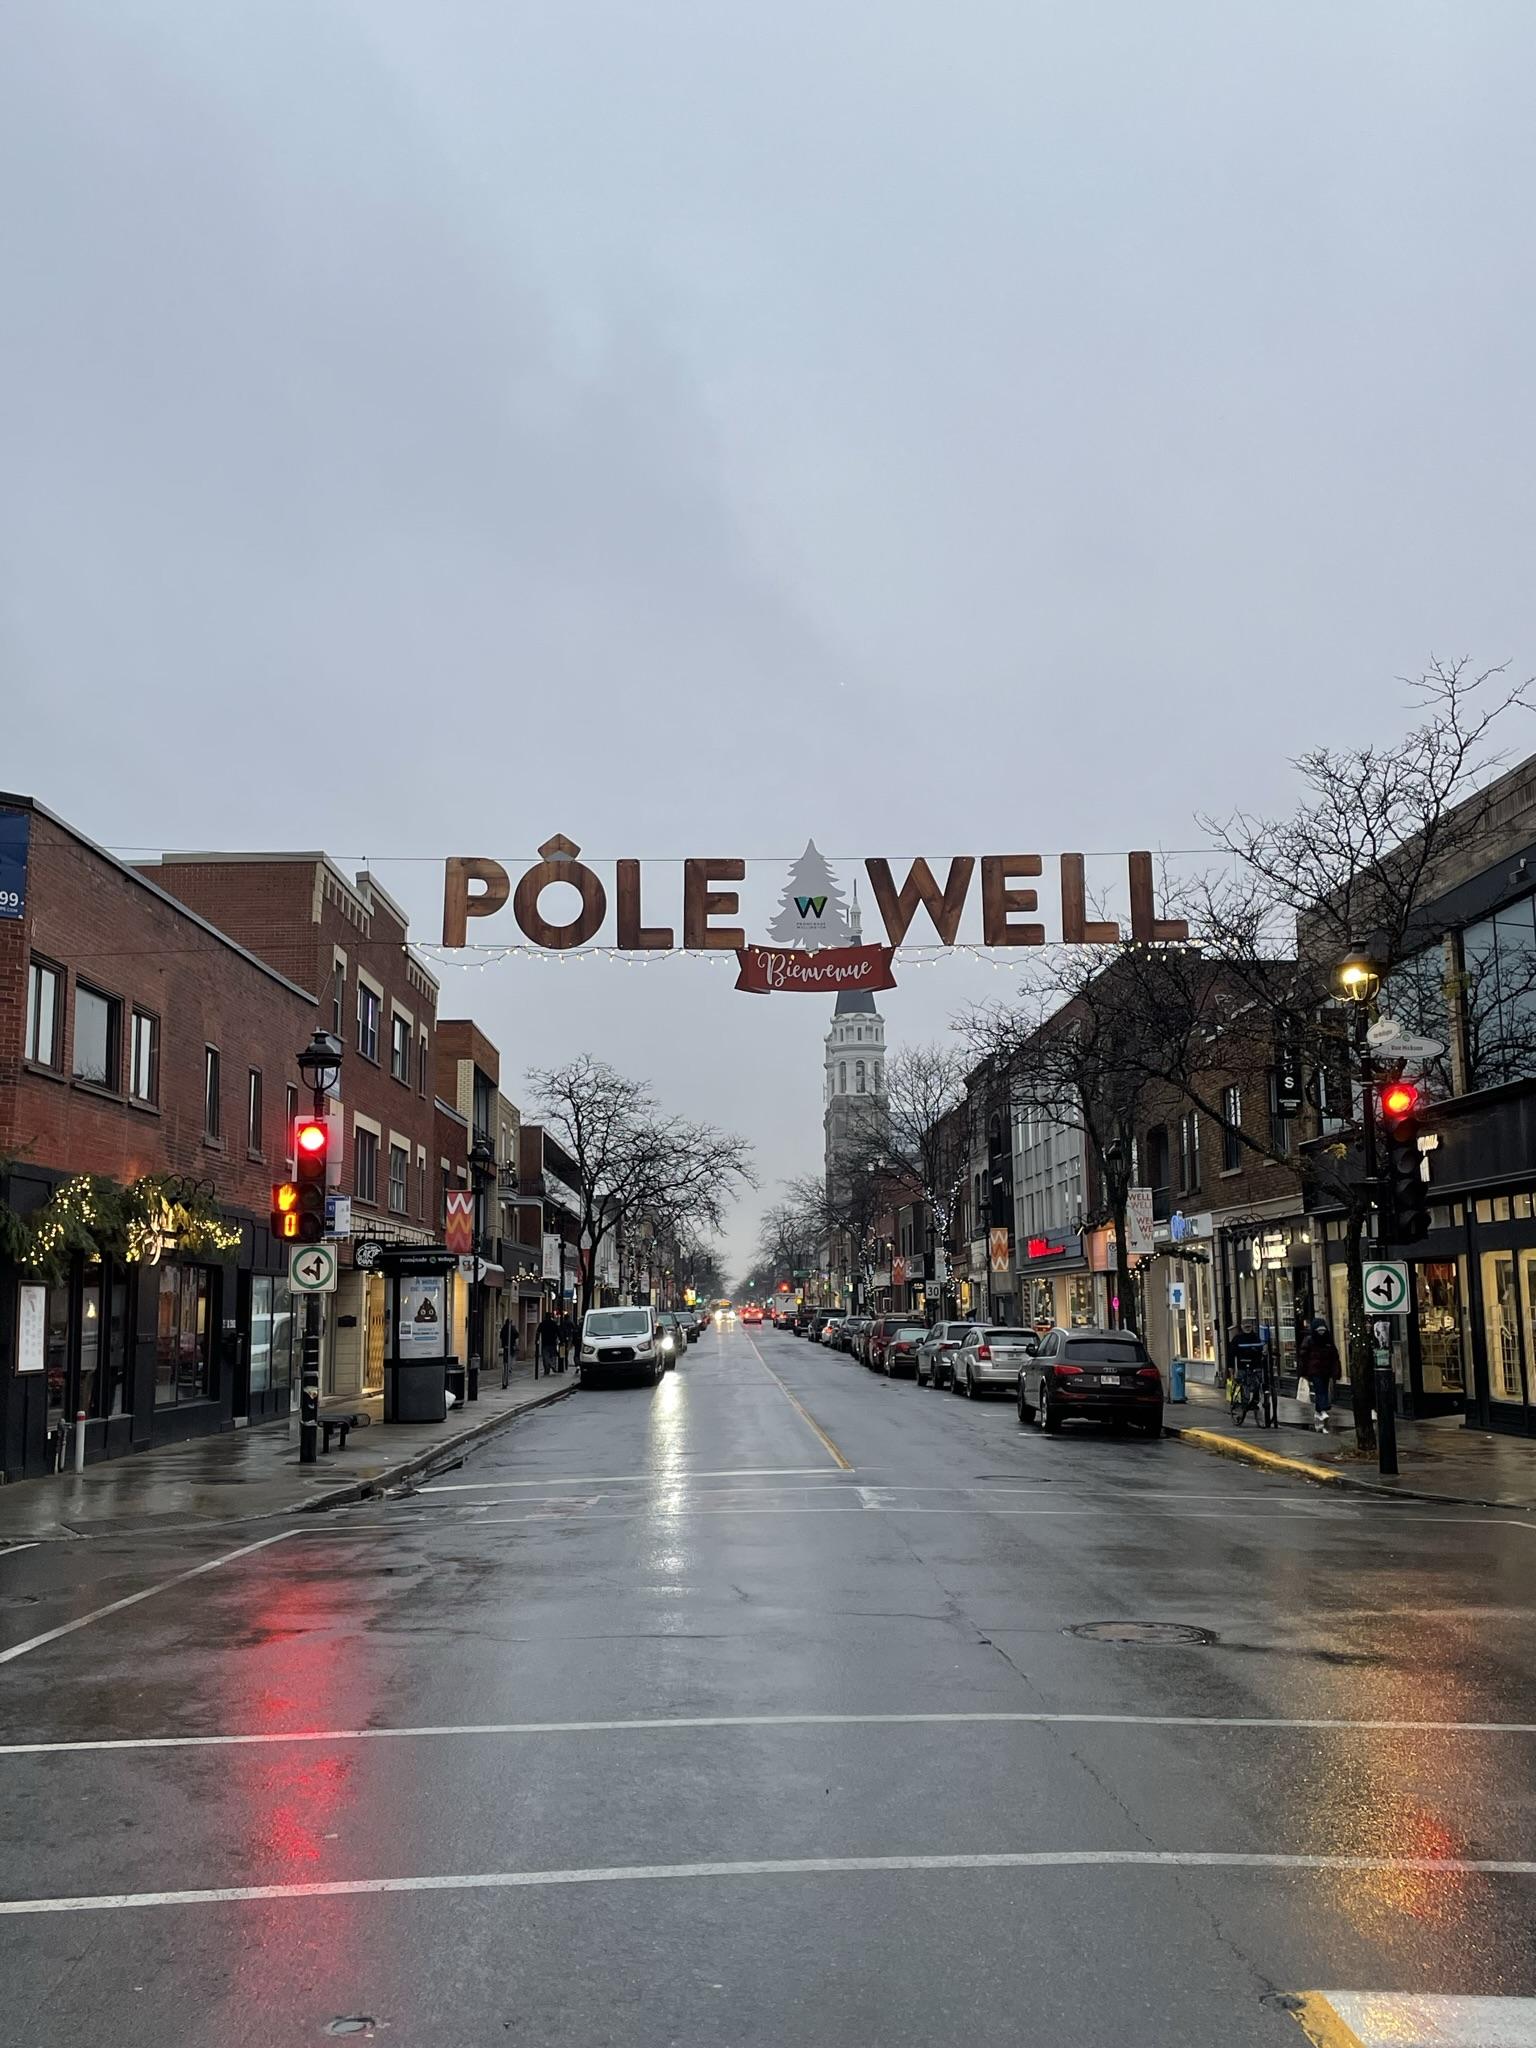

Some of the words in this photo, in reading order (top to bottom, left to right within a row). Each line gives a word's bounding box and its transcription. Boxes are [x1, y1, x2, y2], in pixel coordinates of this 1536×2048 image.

[442, 833, 745, 950] PÔLE
[865, 851, 1188, 946] WELL
[794, 896, 829, 919] W
[757, 952, 873, 987] Bienvenue
[284, 1214, 296, 1237] 0
[927, 1287, 939, 1297] 30
